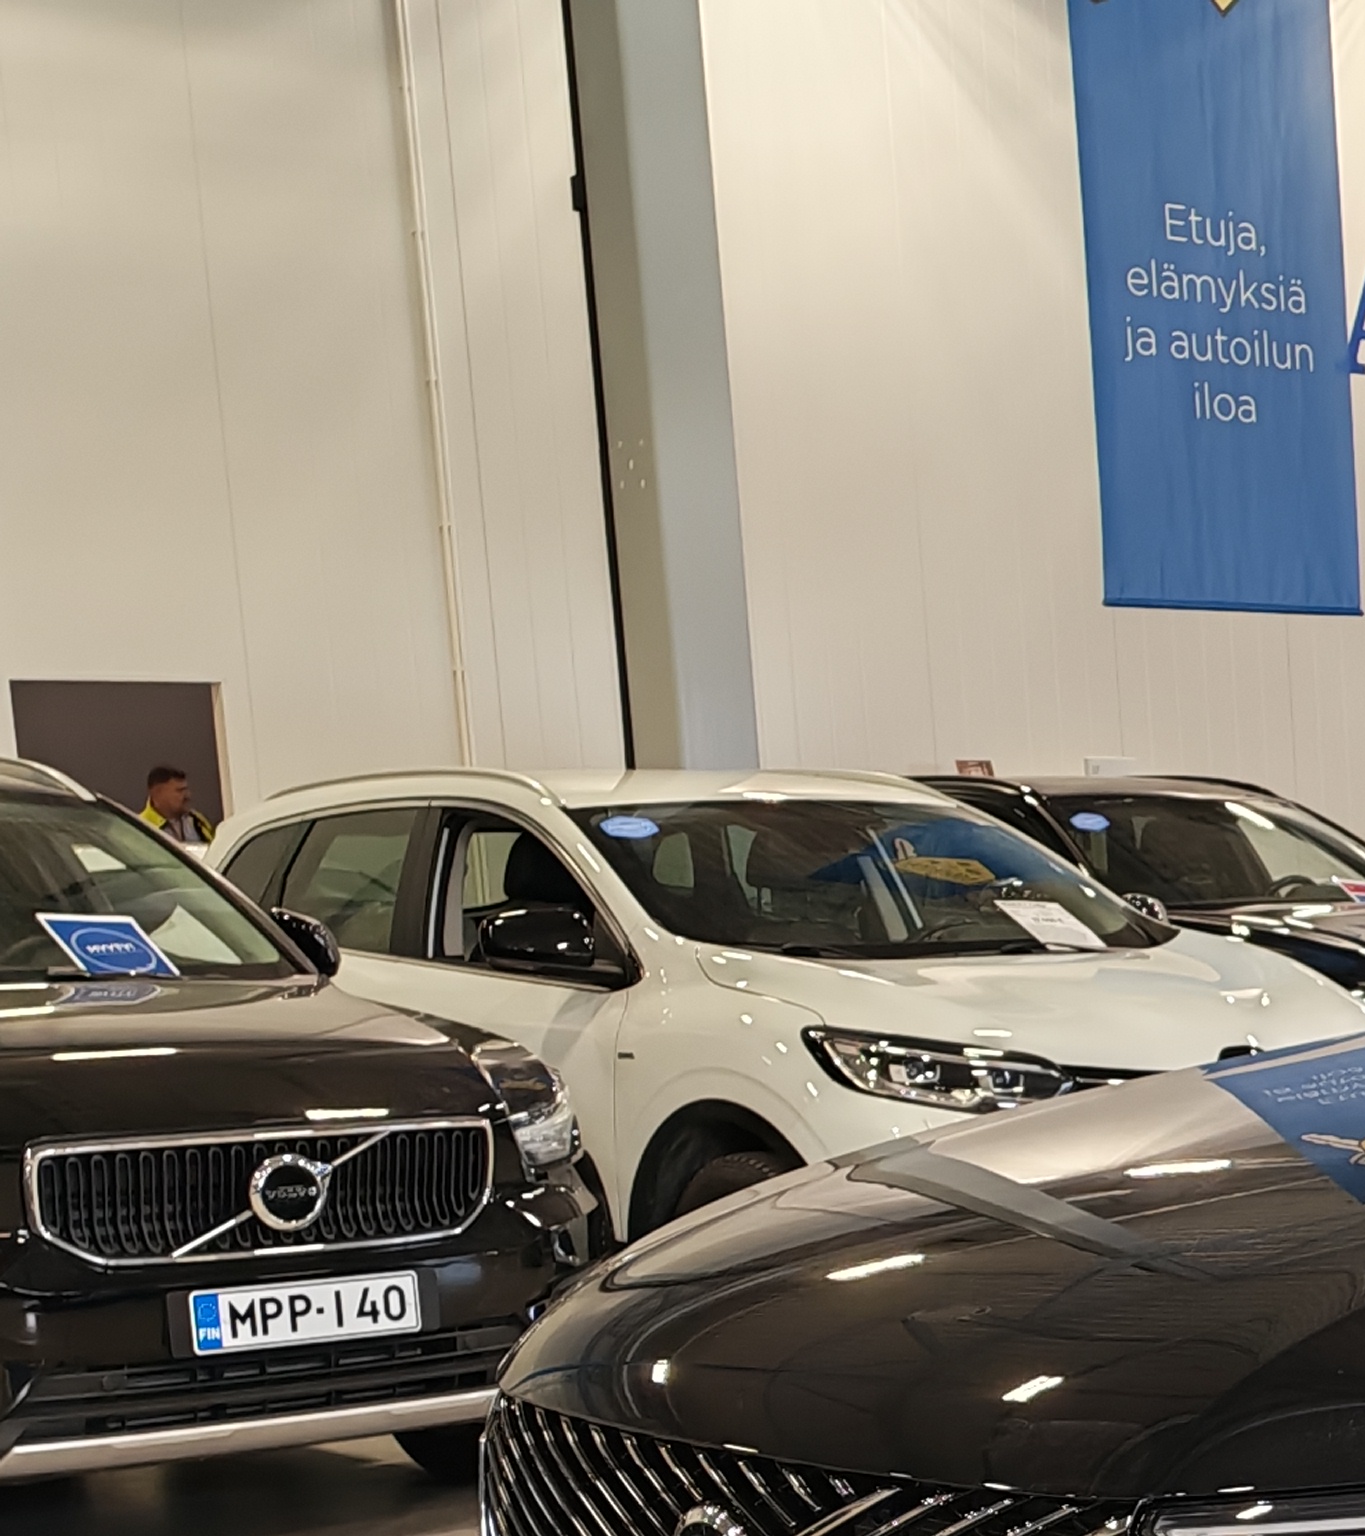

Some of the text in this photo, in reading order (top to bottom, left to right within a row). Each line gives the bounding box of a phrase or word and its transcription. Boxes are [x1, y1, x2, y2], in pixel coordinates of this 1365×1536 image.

[1164, 202, 1266, 257] Etuja,
[1126, 258, 1307, 315] elämyksiä
[1124, 316, 1315, 373] ja autoilun
[1193, 381, 1258, 423] iloa
[198, 1327, 221, 1343] FIN
[228, 1284, 407, 1339] MPP-140
